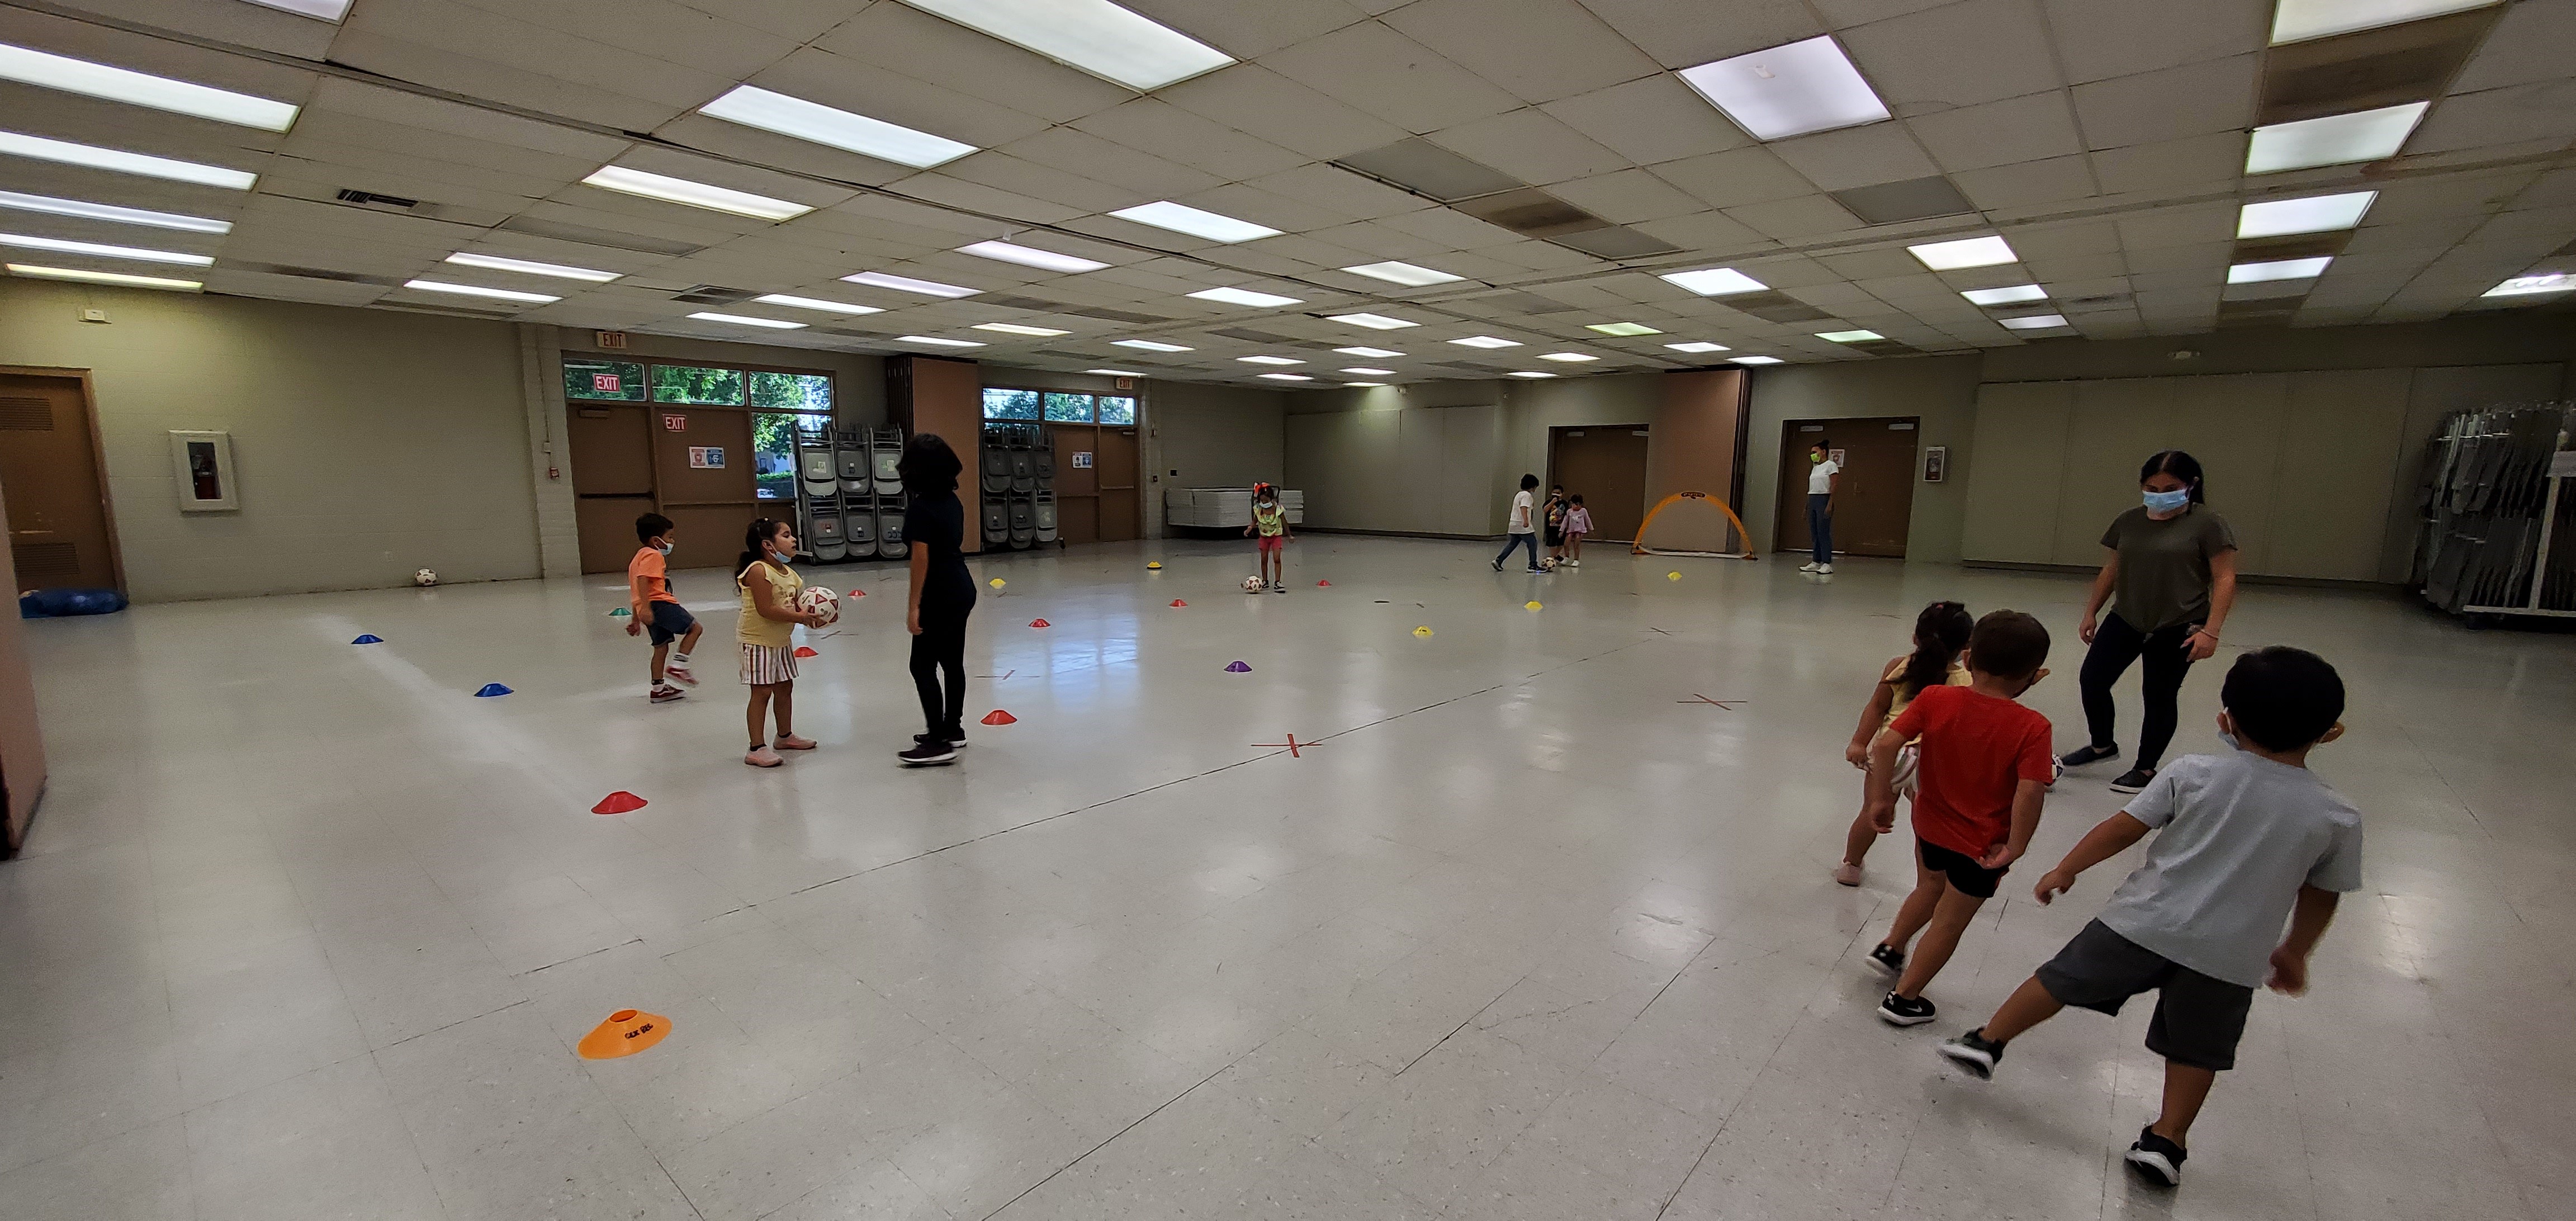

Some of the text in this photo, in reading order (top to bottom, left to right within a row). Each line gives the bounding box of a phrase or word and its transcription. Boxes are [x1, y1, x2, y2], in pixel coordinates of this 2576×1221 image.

[603, 333, 622, 348] EXIT
[596, 376, 618, 391] EXIT
[665, 417, 685, 430] EXIT
